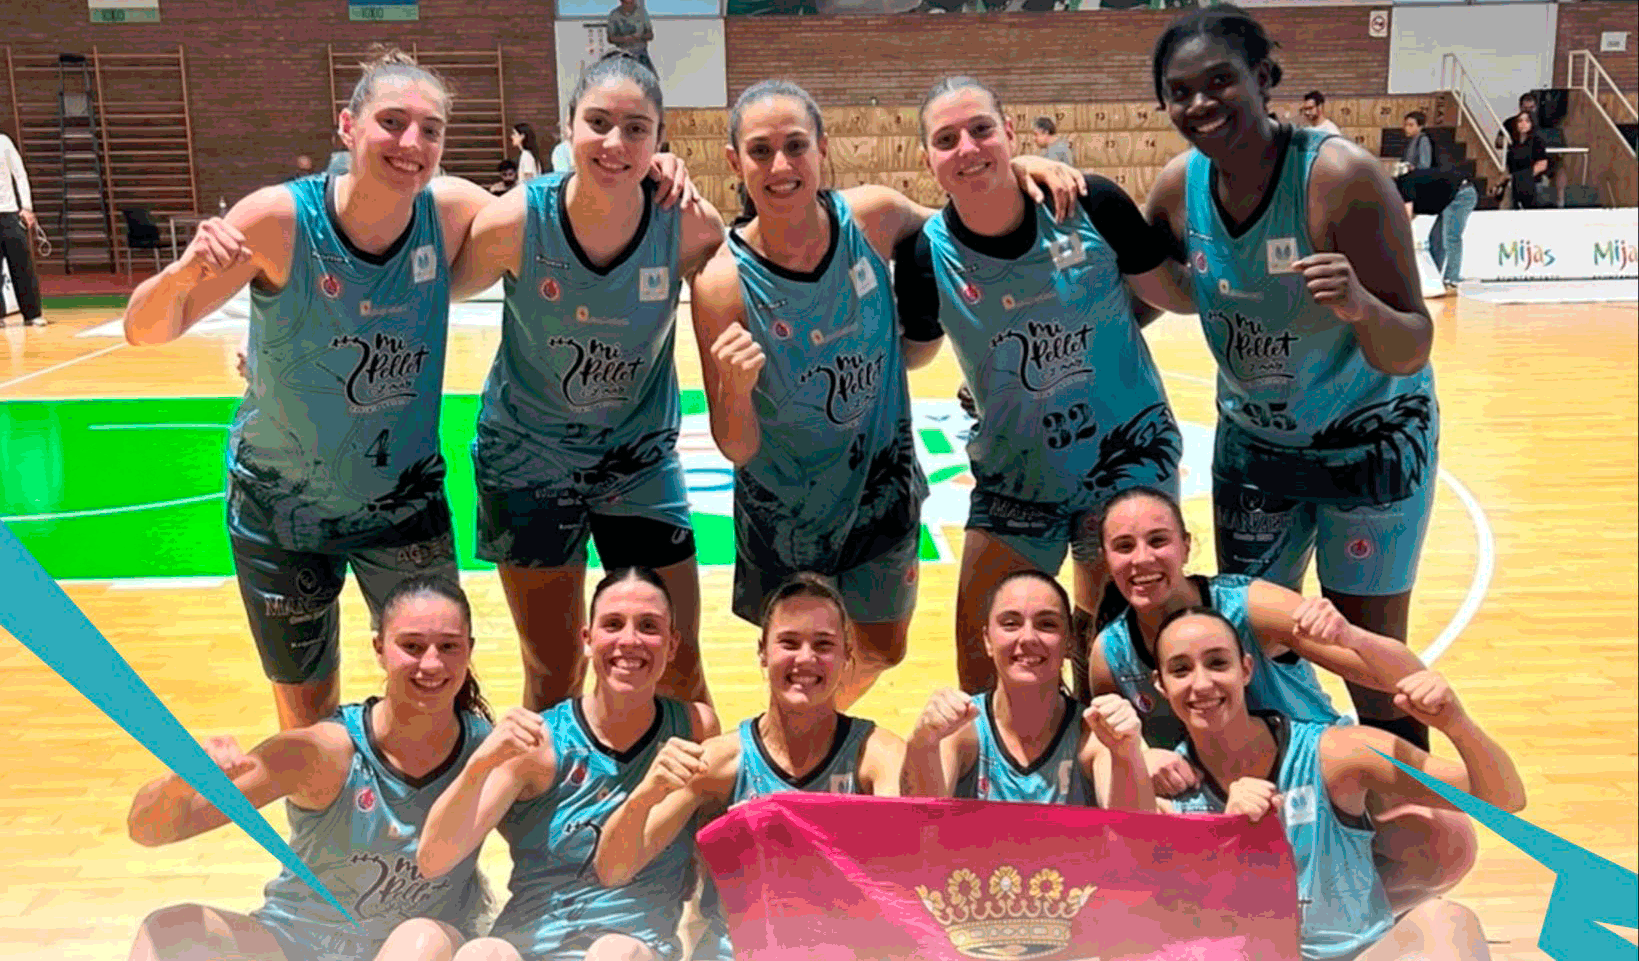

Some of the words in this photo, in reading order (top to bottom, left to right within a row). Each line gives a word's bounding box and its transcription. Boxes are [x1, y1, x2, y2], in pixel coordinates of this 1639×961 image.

[1497, 239, 1557, 271] Mijas
[1593, 239, 1639, 271] Mija
[1041, 402, 1097, 450] 32
[1241, 401, 1298, 431] 95
[363, 427, 392, 467] 4
